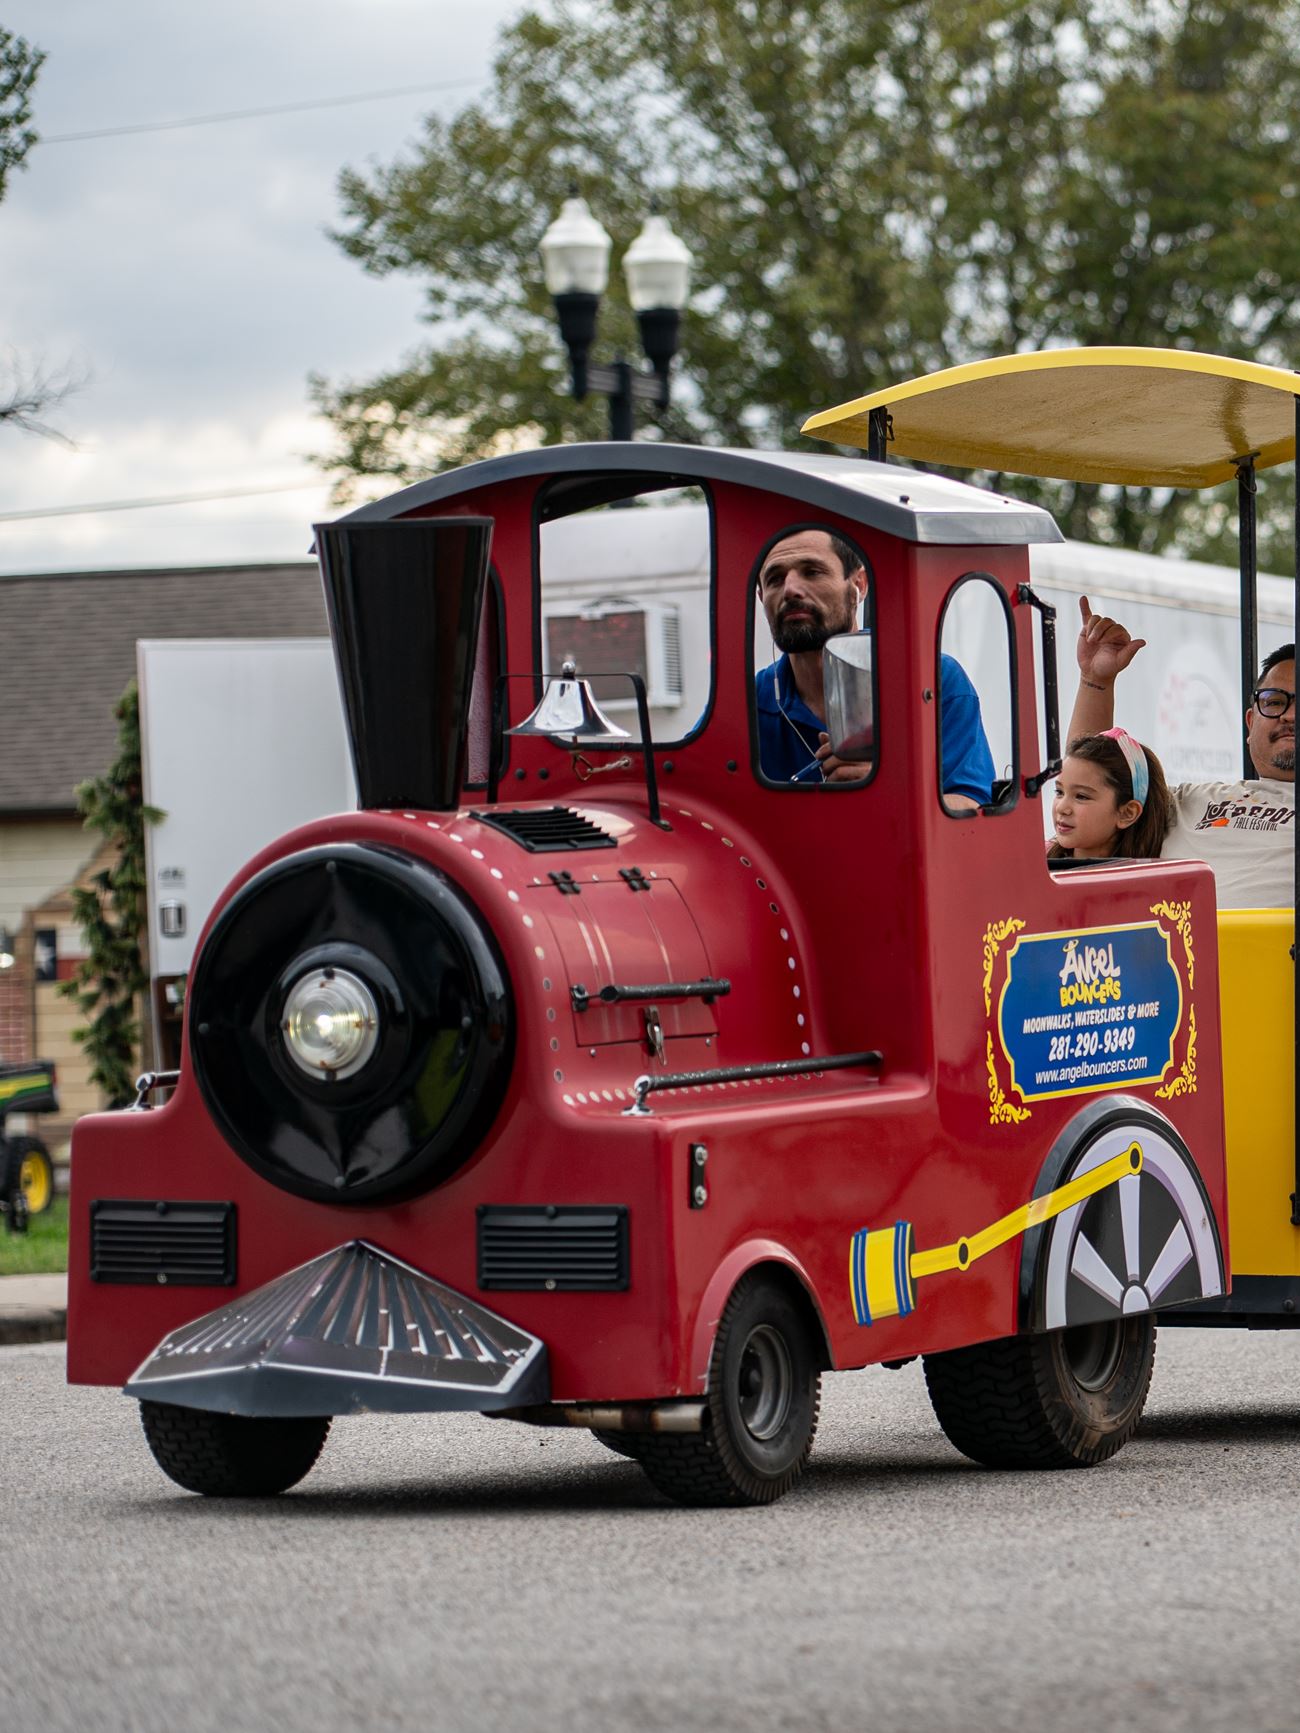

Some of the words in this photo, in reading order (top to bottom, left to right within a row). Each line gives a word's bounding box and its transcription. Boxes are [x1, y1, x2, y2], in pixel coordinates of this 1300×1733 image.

[1233, 817, 1250, 830] FALL
[1249, 818, 1279, 831] FESTIVAL
[1060, 977, 1121, 1008] BOUNCERS
[1022, 1013, 1074, 1035] MOONWALKS,
[1074, 1006, 1125, 1028] WATERSLIDES
[1127, 1003, 1137, 1020] &
[1136, 1000, 1160, 1018] MORE
[1048, 1026, 1136, 1062] 281-290-9349
[1035, 1055, 1148, 1085] www.angelbouncers.com
